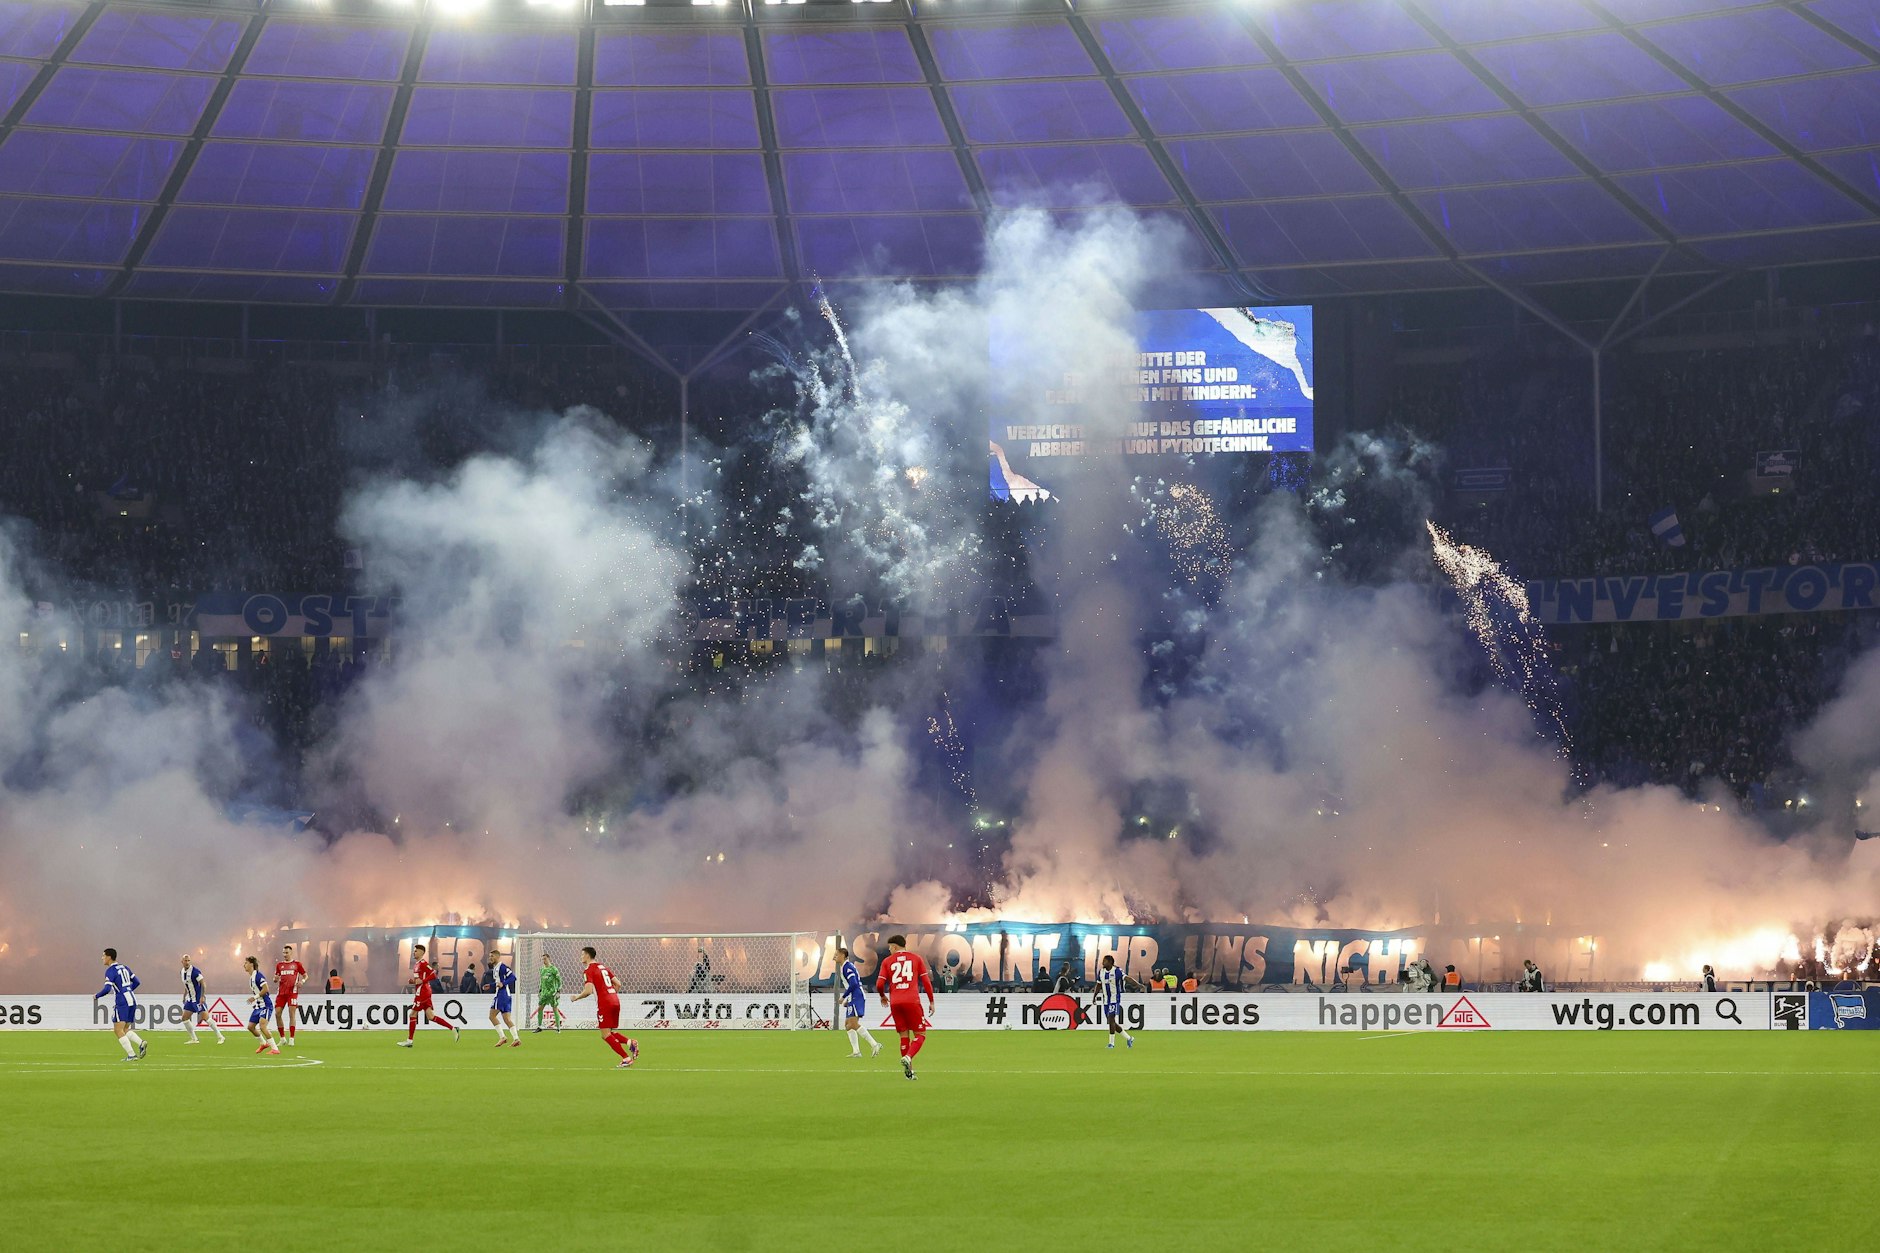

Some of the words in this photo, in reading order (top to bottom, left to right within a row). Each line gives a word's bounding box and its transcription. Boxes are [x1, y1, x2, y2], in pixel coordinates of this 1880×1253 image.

[1176, 351, 1206, 366] DER
[1163, 368, 1201, 383] FANS
[1205, 368, 1237, 382] UND
[1152, 386, 1179, 401] MIT
[1183, 385, 1257, 400] KINDERN:
[1007, 425, 1090, 440] VERZICHT
[1161, 421, 1190, 436] DAS
[1194, 417, 1296, 434] GEFÄHRLICHE
[1126, 440, 1158, 455] VON
[1162, 437, 1273, 453] PYROTECHNIK.
[66, 601, 154, 628] NORD
[167, 601, 199, 628] 97
[243, 594, 398, 637] OST
[794, 932, 879, 981] DAS
[903, 924, 1061, 983] KÖNNT
[1083, 934, 1158, 986] IHR
[1184, 935, 1269, 986] UNS
[1293, 938, 1426, 985] NICHT
[117, 968, 131, 988] 10
[601, 969, 612, 988] 6
[890, 960, 914, 984] 24
[93, 999, 203, 1030] hppe
[1170, 997, 1260, 1025] ideas
[1319, 997, 1443, 1031] happen
[1454, 1010, 1473, 1023] WTG
[1551, 998, 1700, 1031] wtg.com
